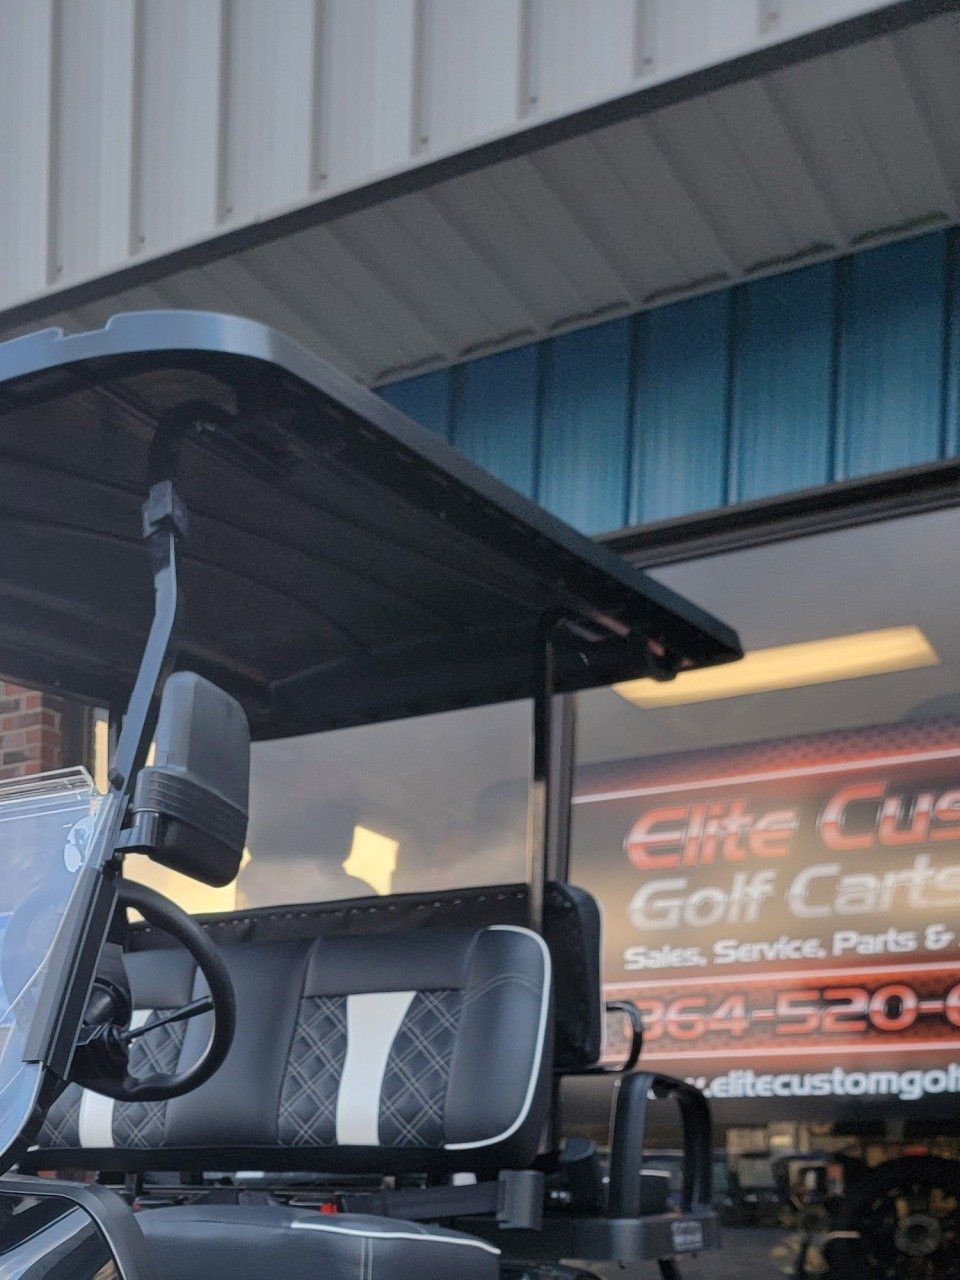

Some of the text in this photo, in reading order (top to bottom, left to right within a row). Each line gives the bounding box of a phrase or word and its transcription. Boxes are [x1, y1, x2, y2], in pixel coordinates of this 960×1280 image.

[623, 800, 799, 871] Elite
[627, 869, 777, 931] Golf
[623, 923, 956, 971] Sales, Service, Parts &
[623, 984, 960, 1041] 864-520-
